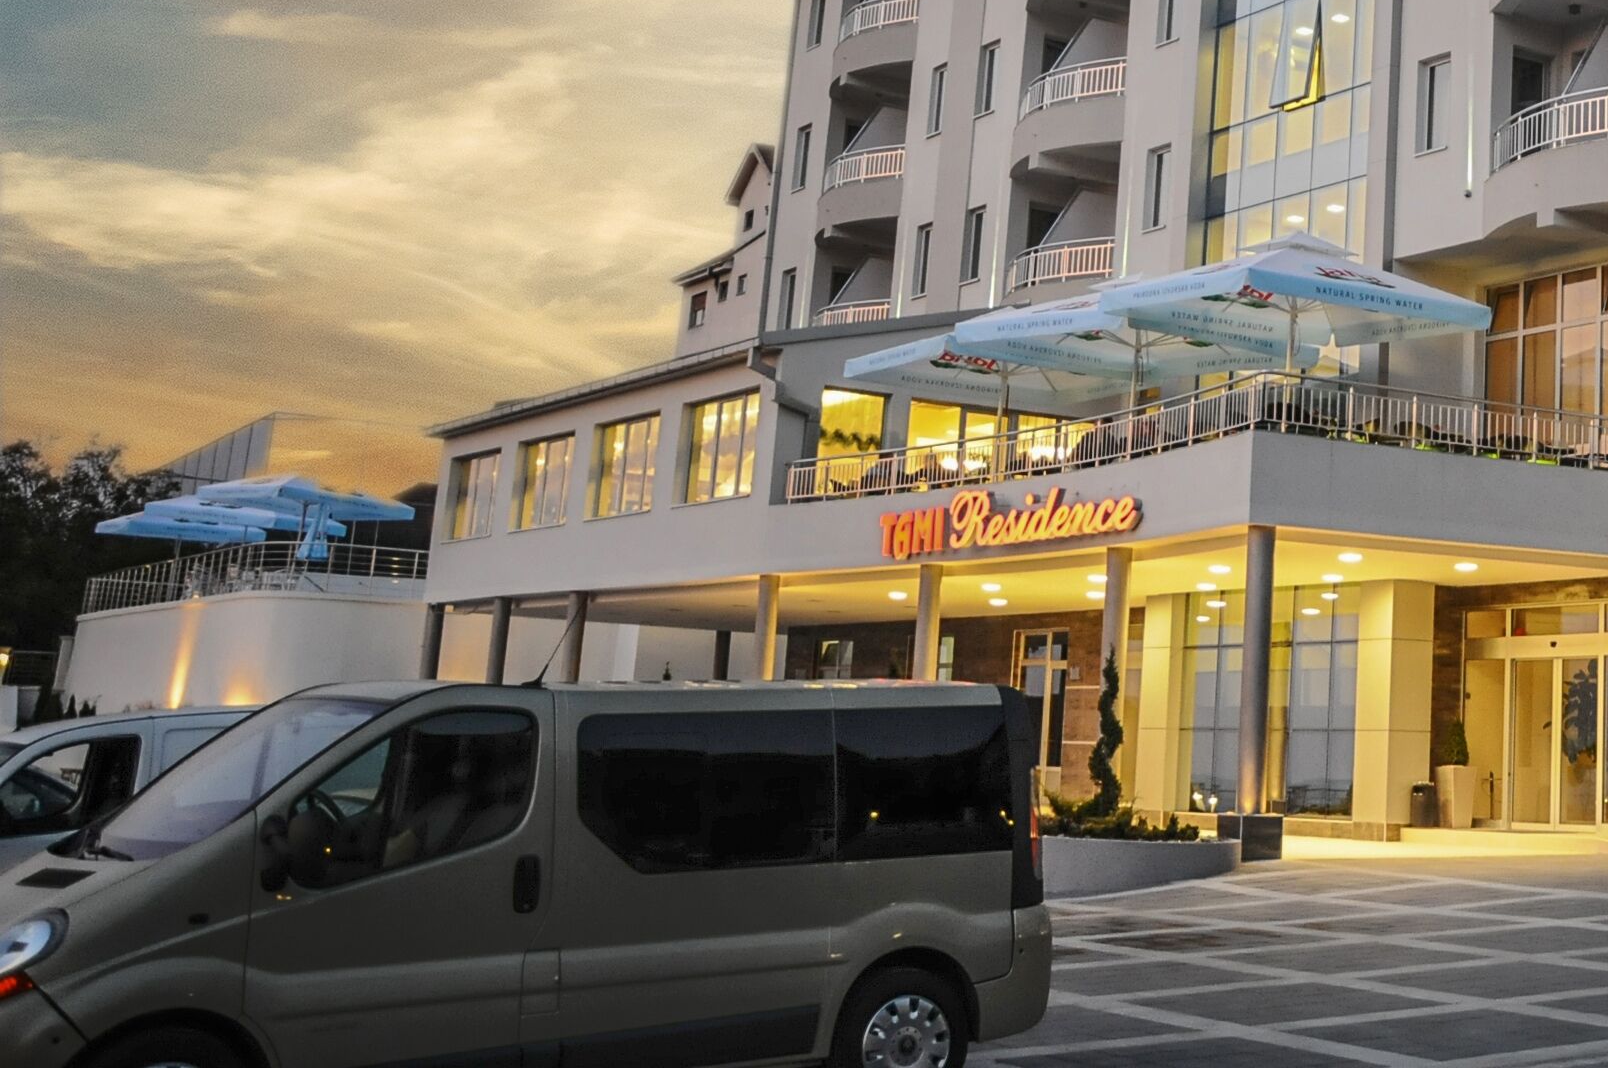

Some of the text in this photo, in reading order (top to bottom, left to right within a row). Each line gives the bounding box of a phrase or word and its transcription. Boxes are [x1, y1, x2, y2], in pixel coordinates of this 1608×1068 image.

[1316, 286, 1423, 310] NATURAL SPRING WATER
[950, 487, 1140, 549] Residence
